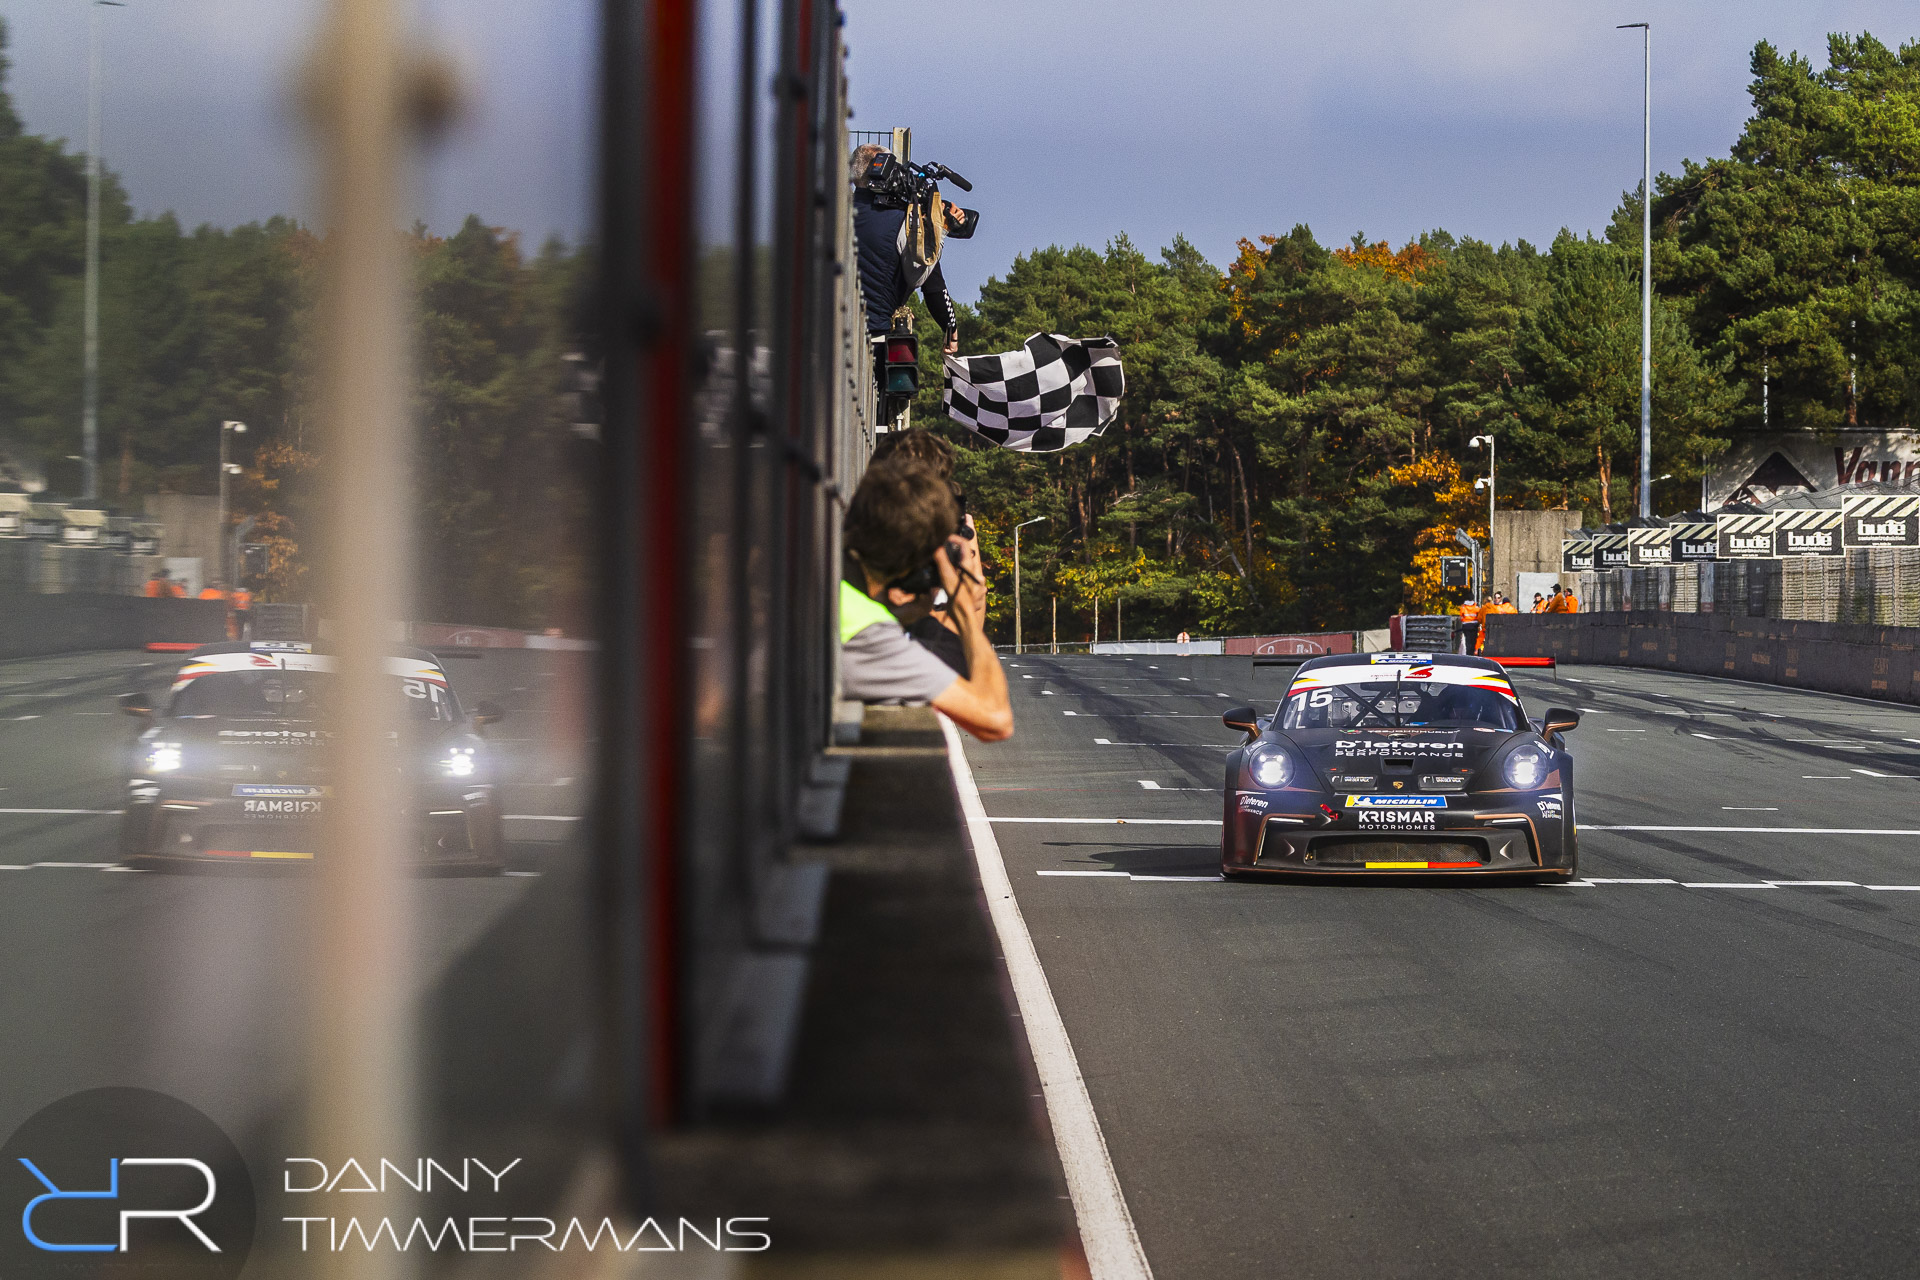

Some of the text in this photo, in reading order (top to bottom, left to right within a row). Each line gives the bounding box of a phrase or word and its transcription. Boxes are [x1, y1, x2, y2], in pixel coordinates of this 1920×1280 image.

[1291, 687, 1333, 712] 15
[1335, 740, 1463, 749] D'Ieteren
[1358, 810, 1436, 823] KRISMAR
